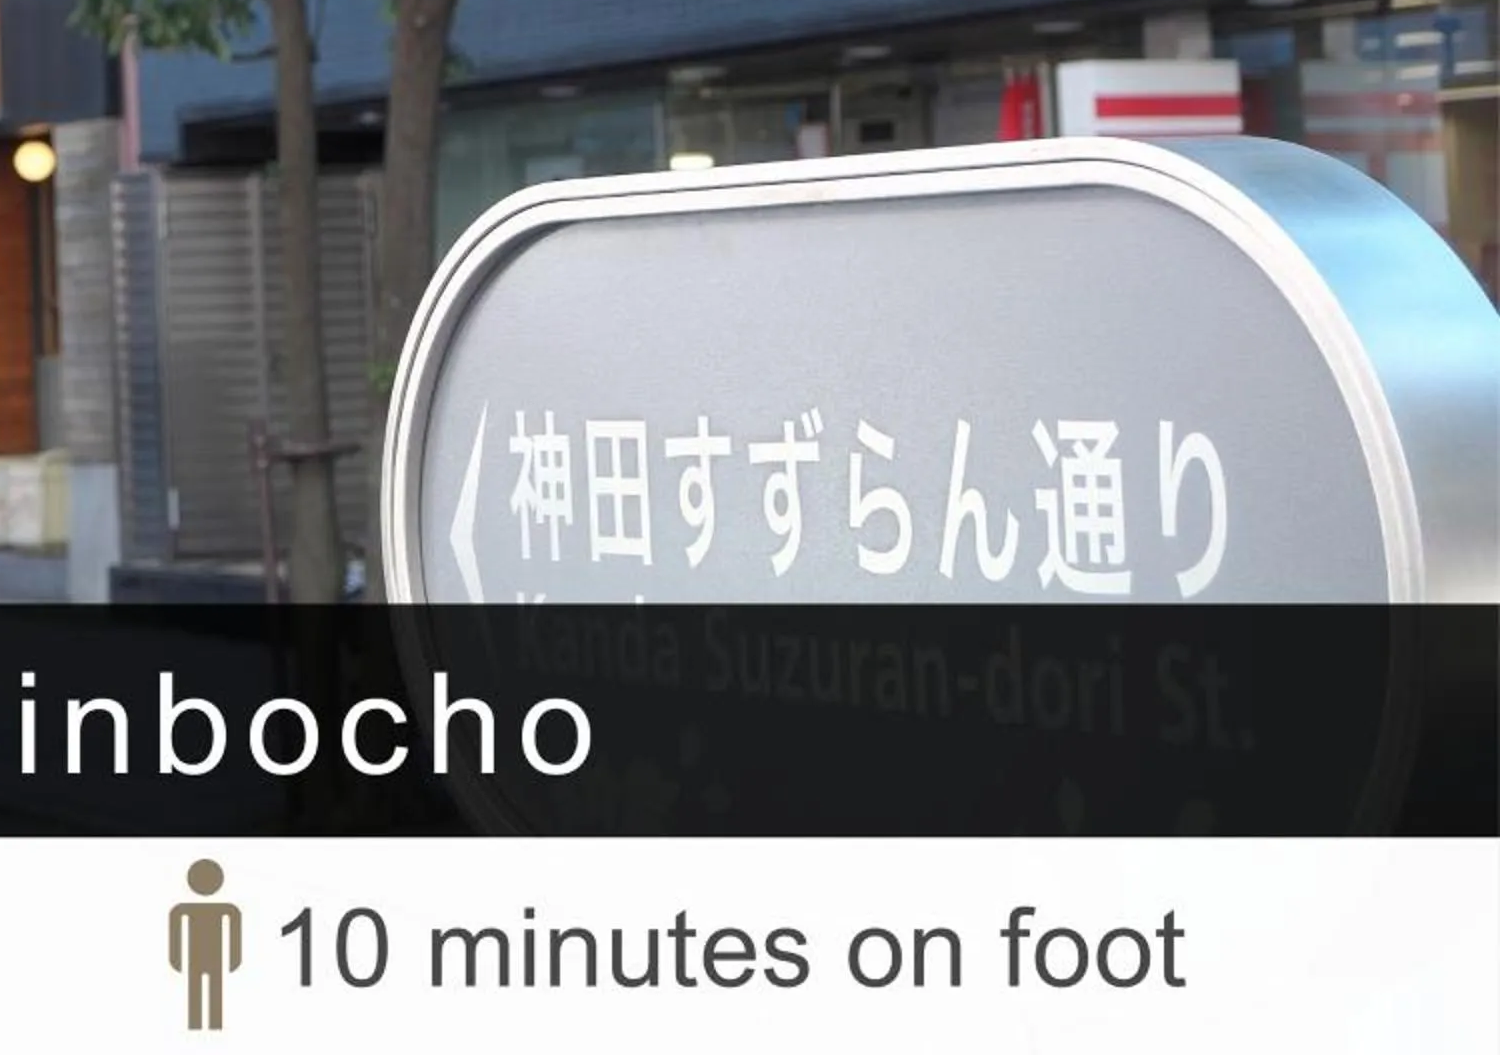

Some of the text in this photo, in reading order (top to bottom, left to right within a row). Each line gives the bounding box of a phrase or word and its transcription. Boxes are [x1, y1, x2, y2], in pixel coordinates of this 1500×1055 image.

[508, 406, 1229, 599] 神田すずらん通り
[515, 590, 682, 686] Kanda
[703, 605, 1127, 736] Suzuran-dori
